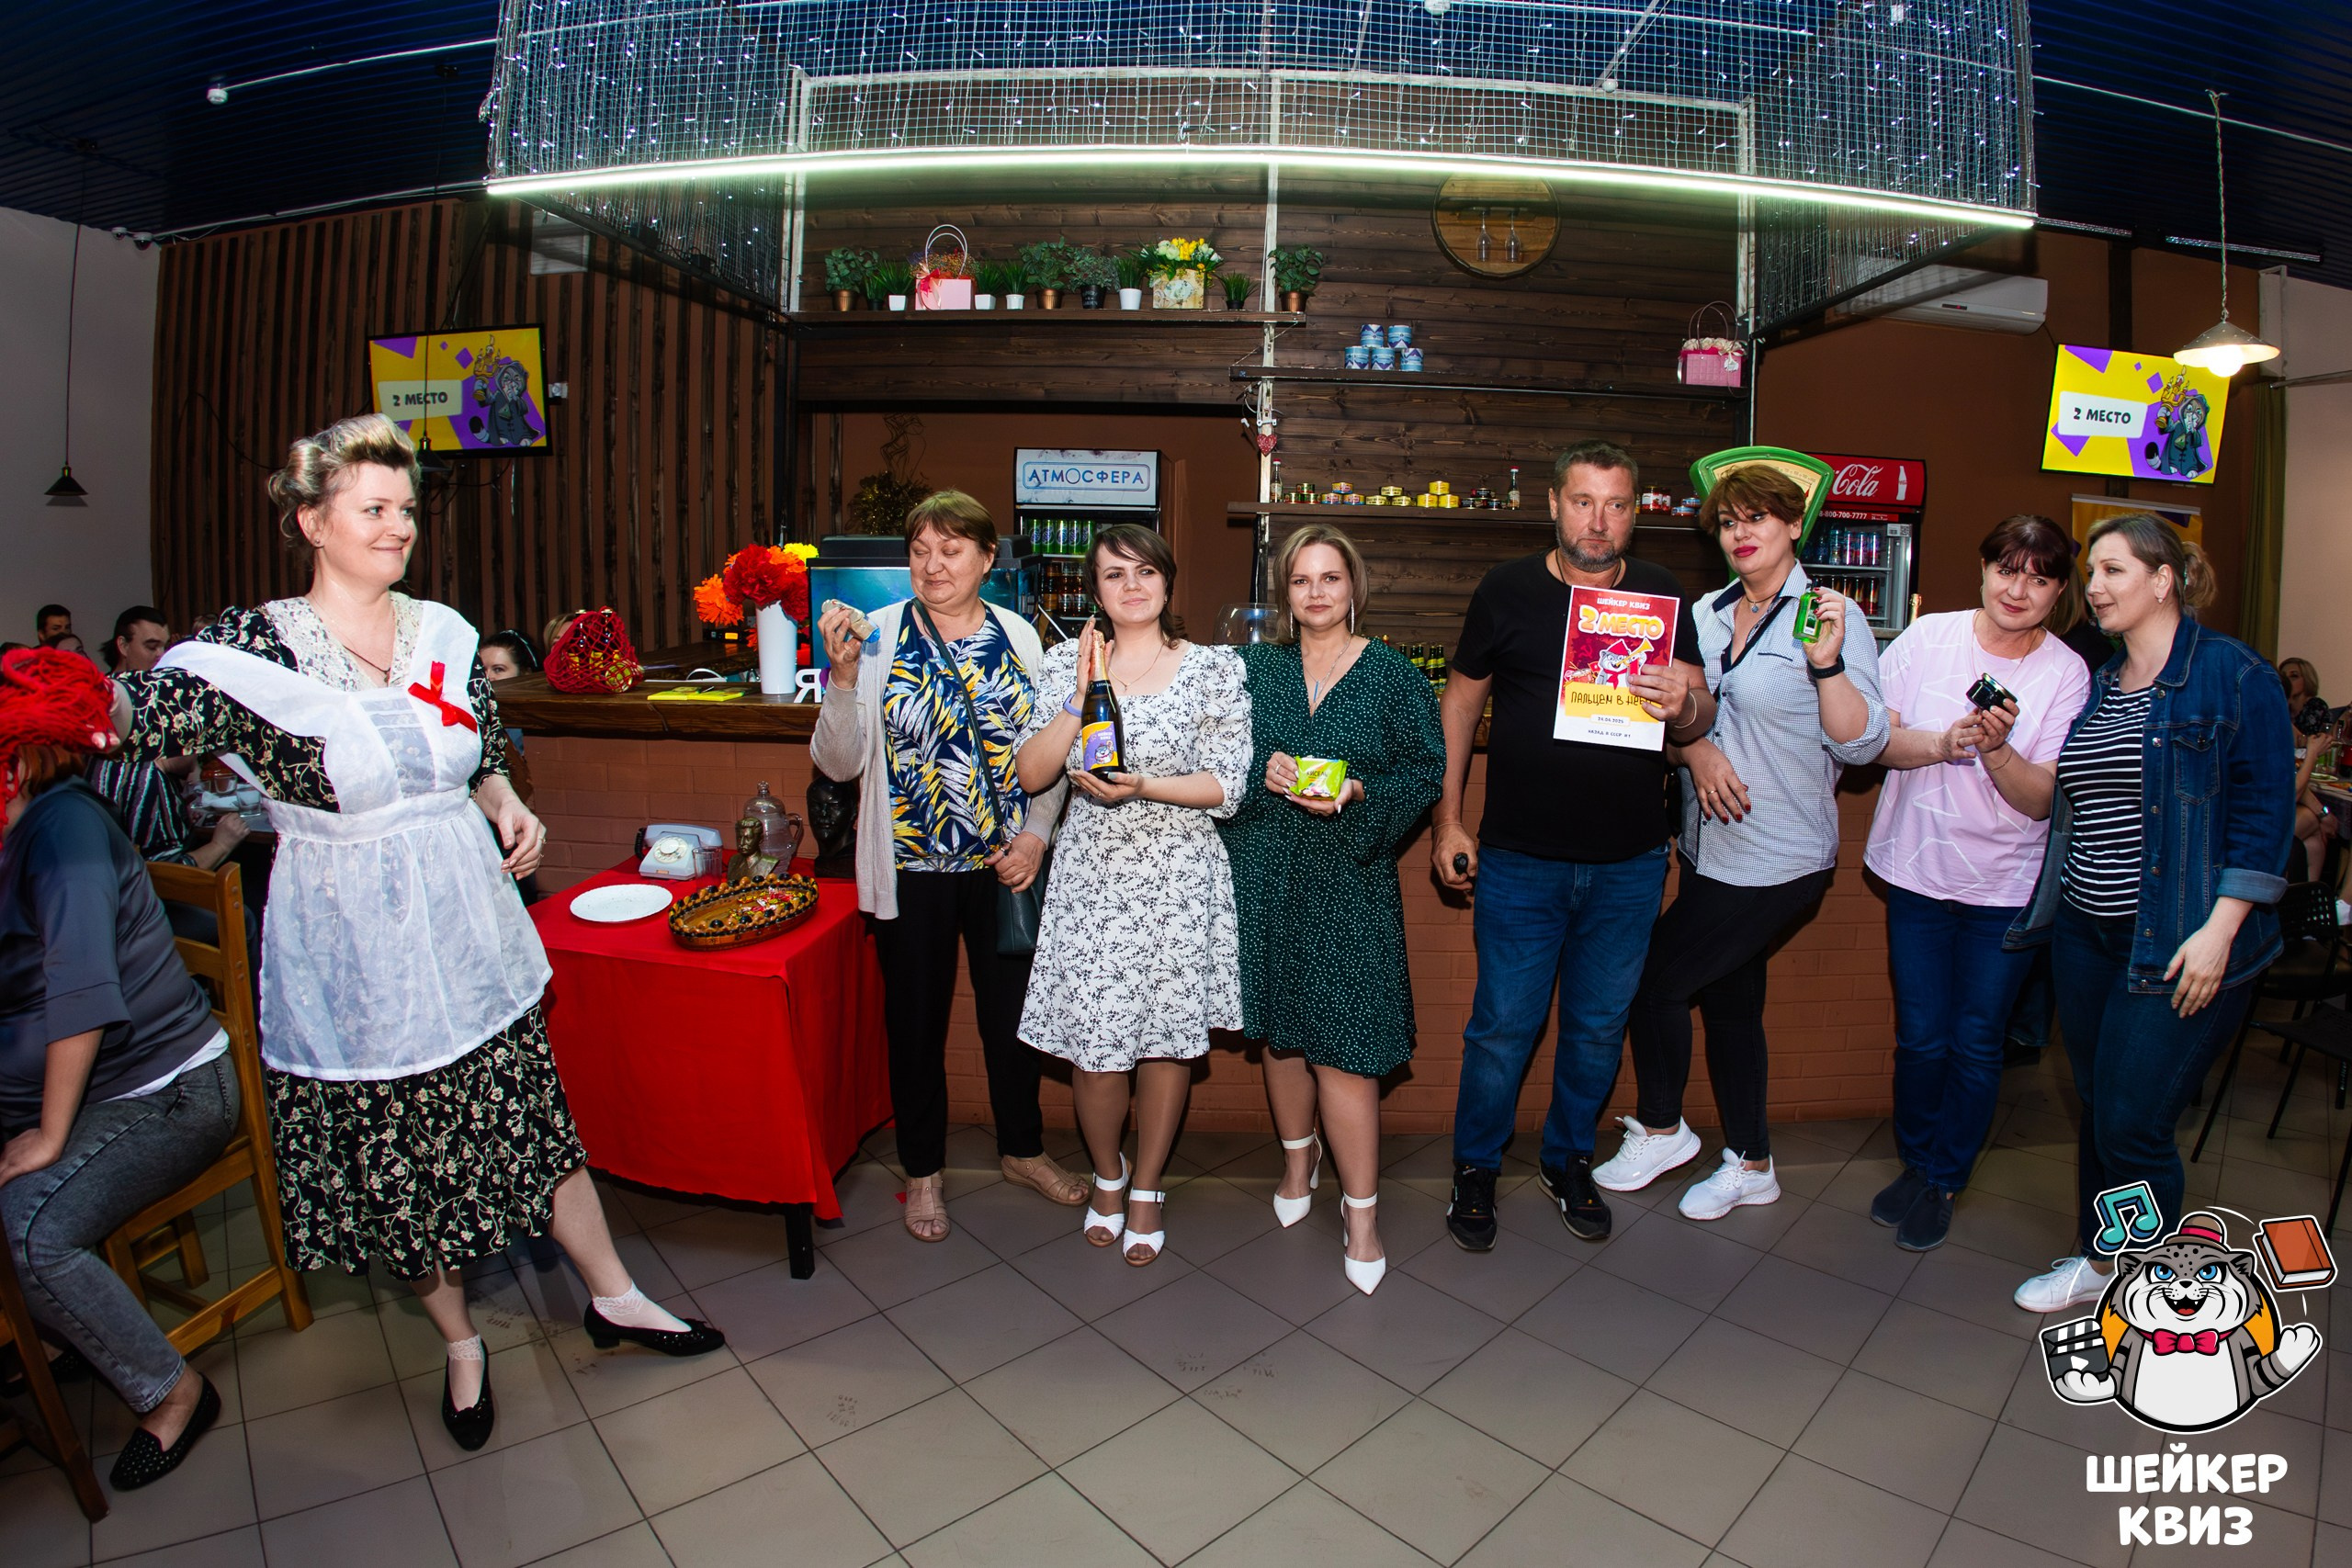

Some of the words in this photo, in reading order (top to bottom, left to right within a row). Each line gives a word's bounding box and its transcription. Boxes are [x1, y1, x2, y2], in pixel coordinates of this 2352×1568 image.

[392, 395, 401, 407] 2
[405, 391, 448, 406] МЕСТО
[2073, 406, 2082, 421] 2
[2086, 408, 2132, 424] МЕСТО
[1028, 468, 1144, 484] АТМОСФЕРА
[1597, 597, 1628, 607] ШЕЙКЕР
[1629, 601, 1651, 611] КВИЗ
[1579, 606, 1598, 632] 2
[1598, 613, 1664, 639] МЕСТО
[794, 669, 822, 704] Я
[1616, 695, 1624, 705] В
